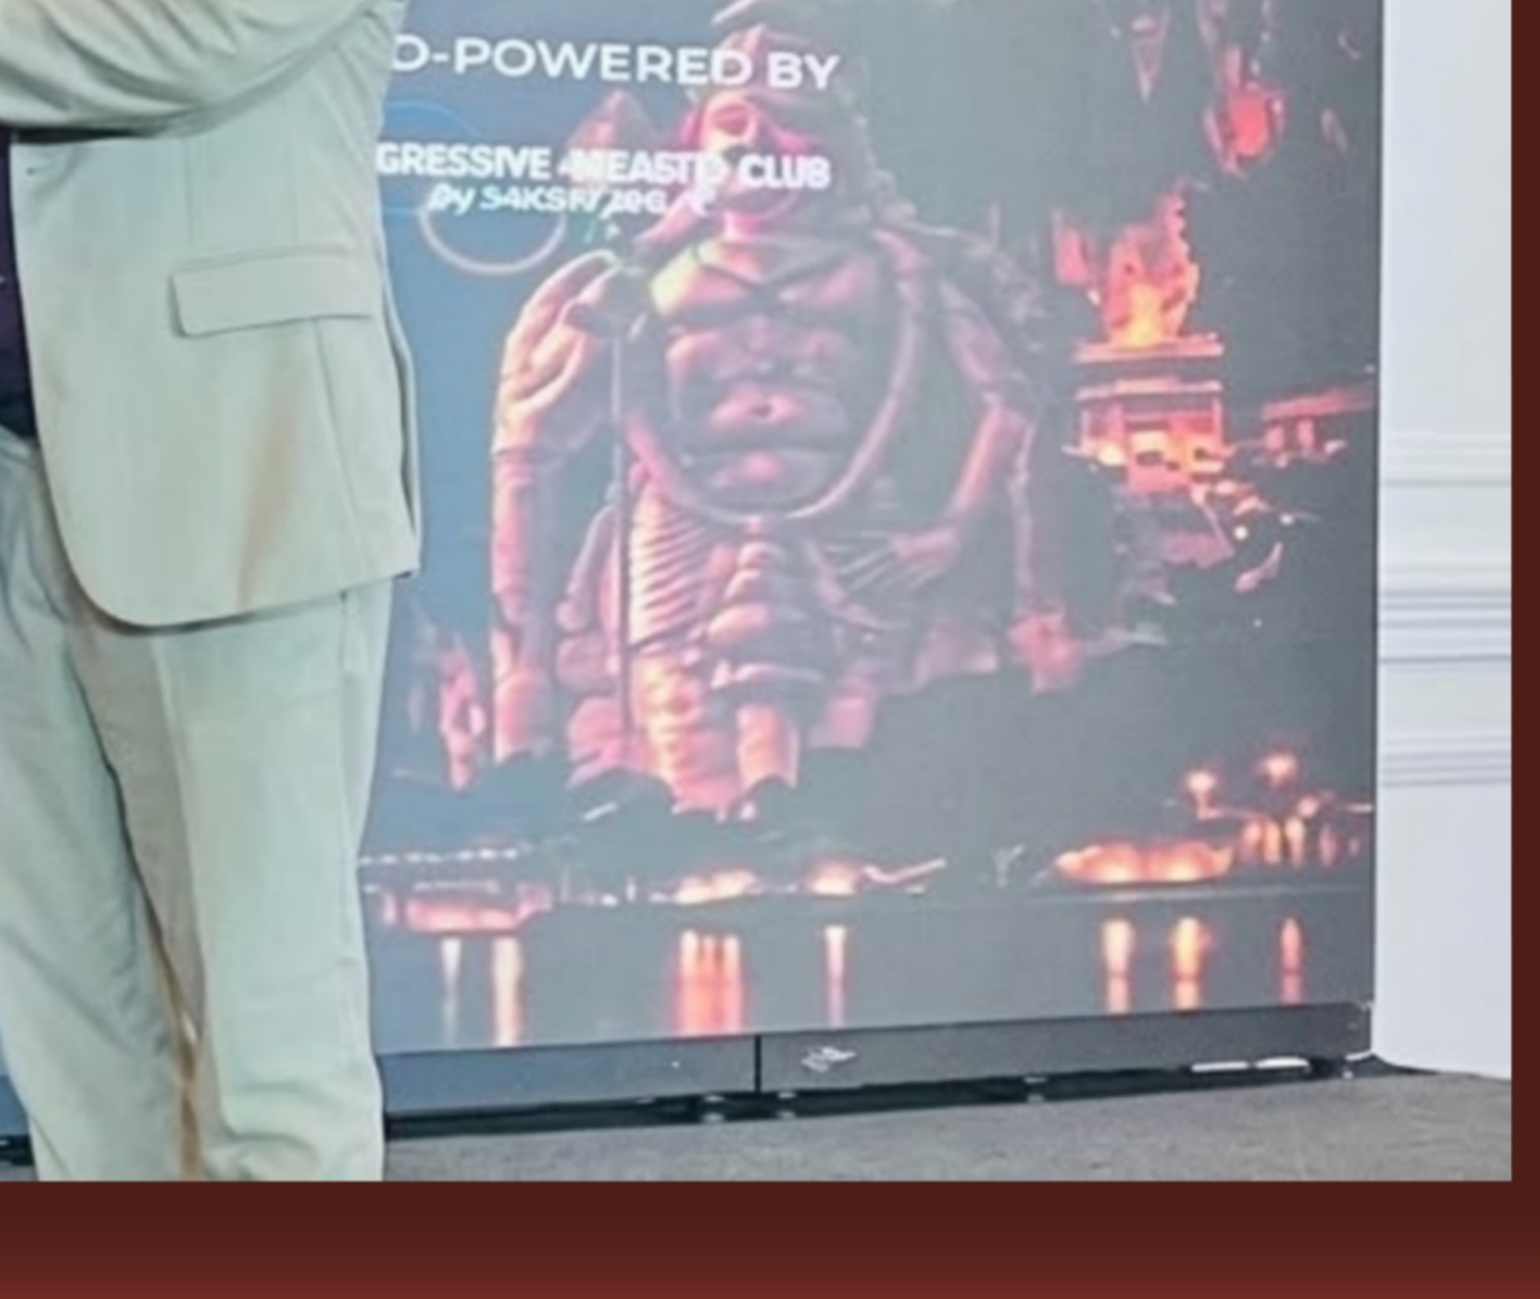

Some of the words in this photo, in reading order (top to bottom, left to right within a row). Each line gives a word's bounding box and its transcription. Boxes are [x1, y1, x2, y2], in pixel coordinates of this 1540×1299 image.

[391, 34, 753, 88] O-POWERED
[767, 52, 841, 90] BY
[376, 142, 552, 181] GRESSIVE
[739, 154, 831, 190] CLUB
